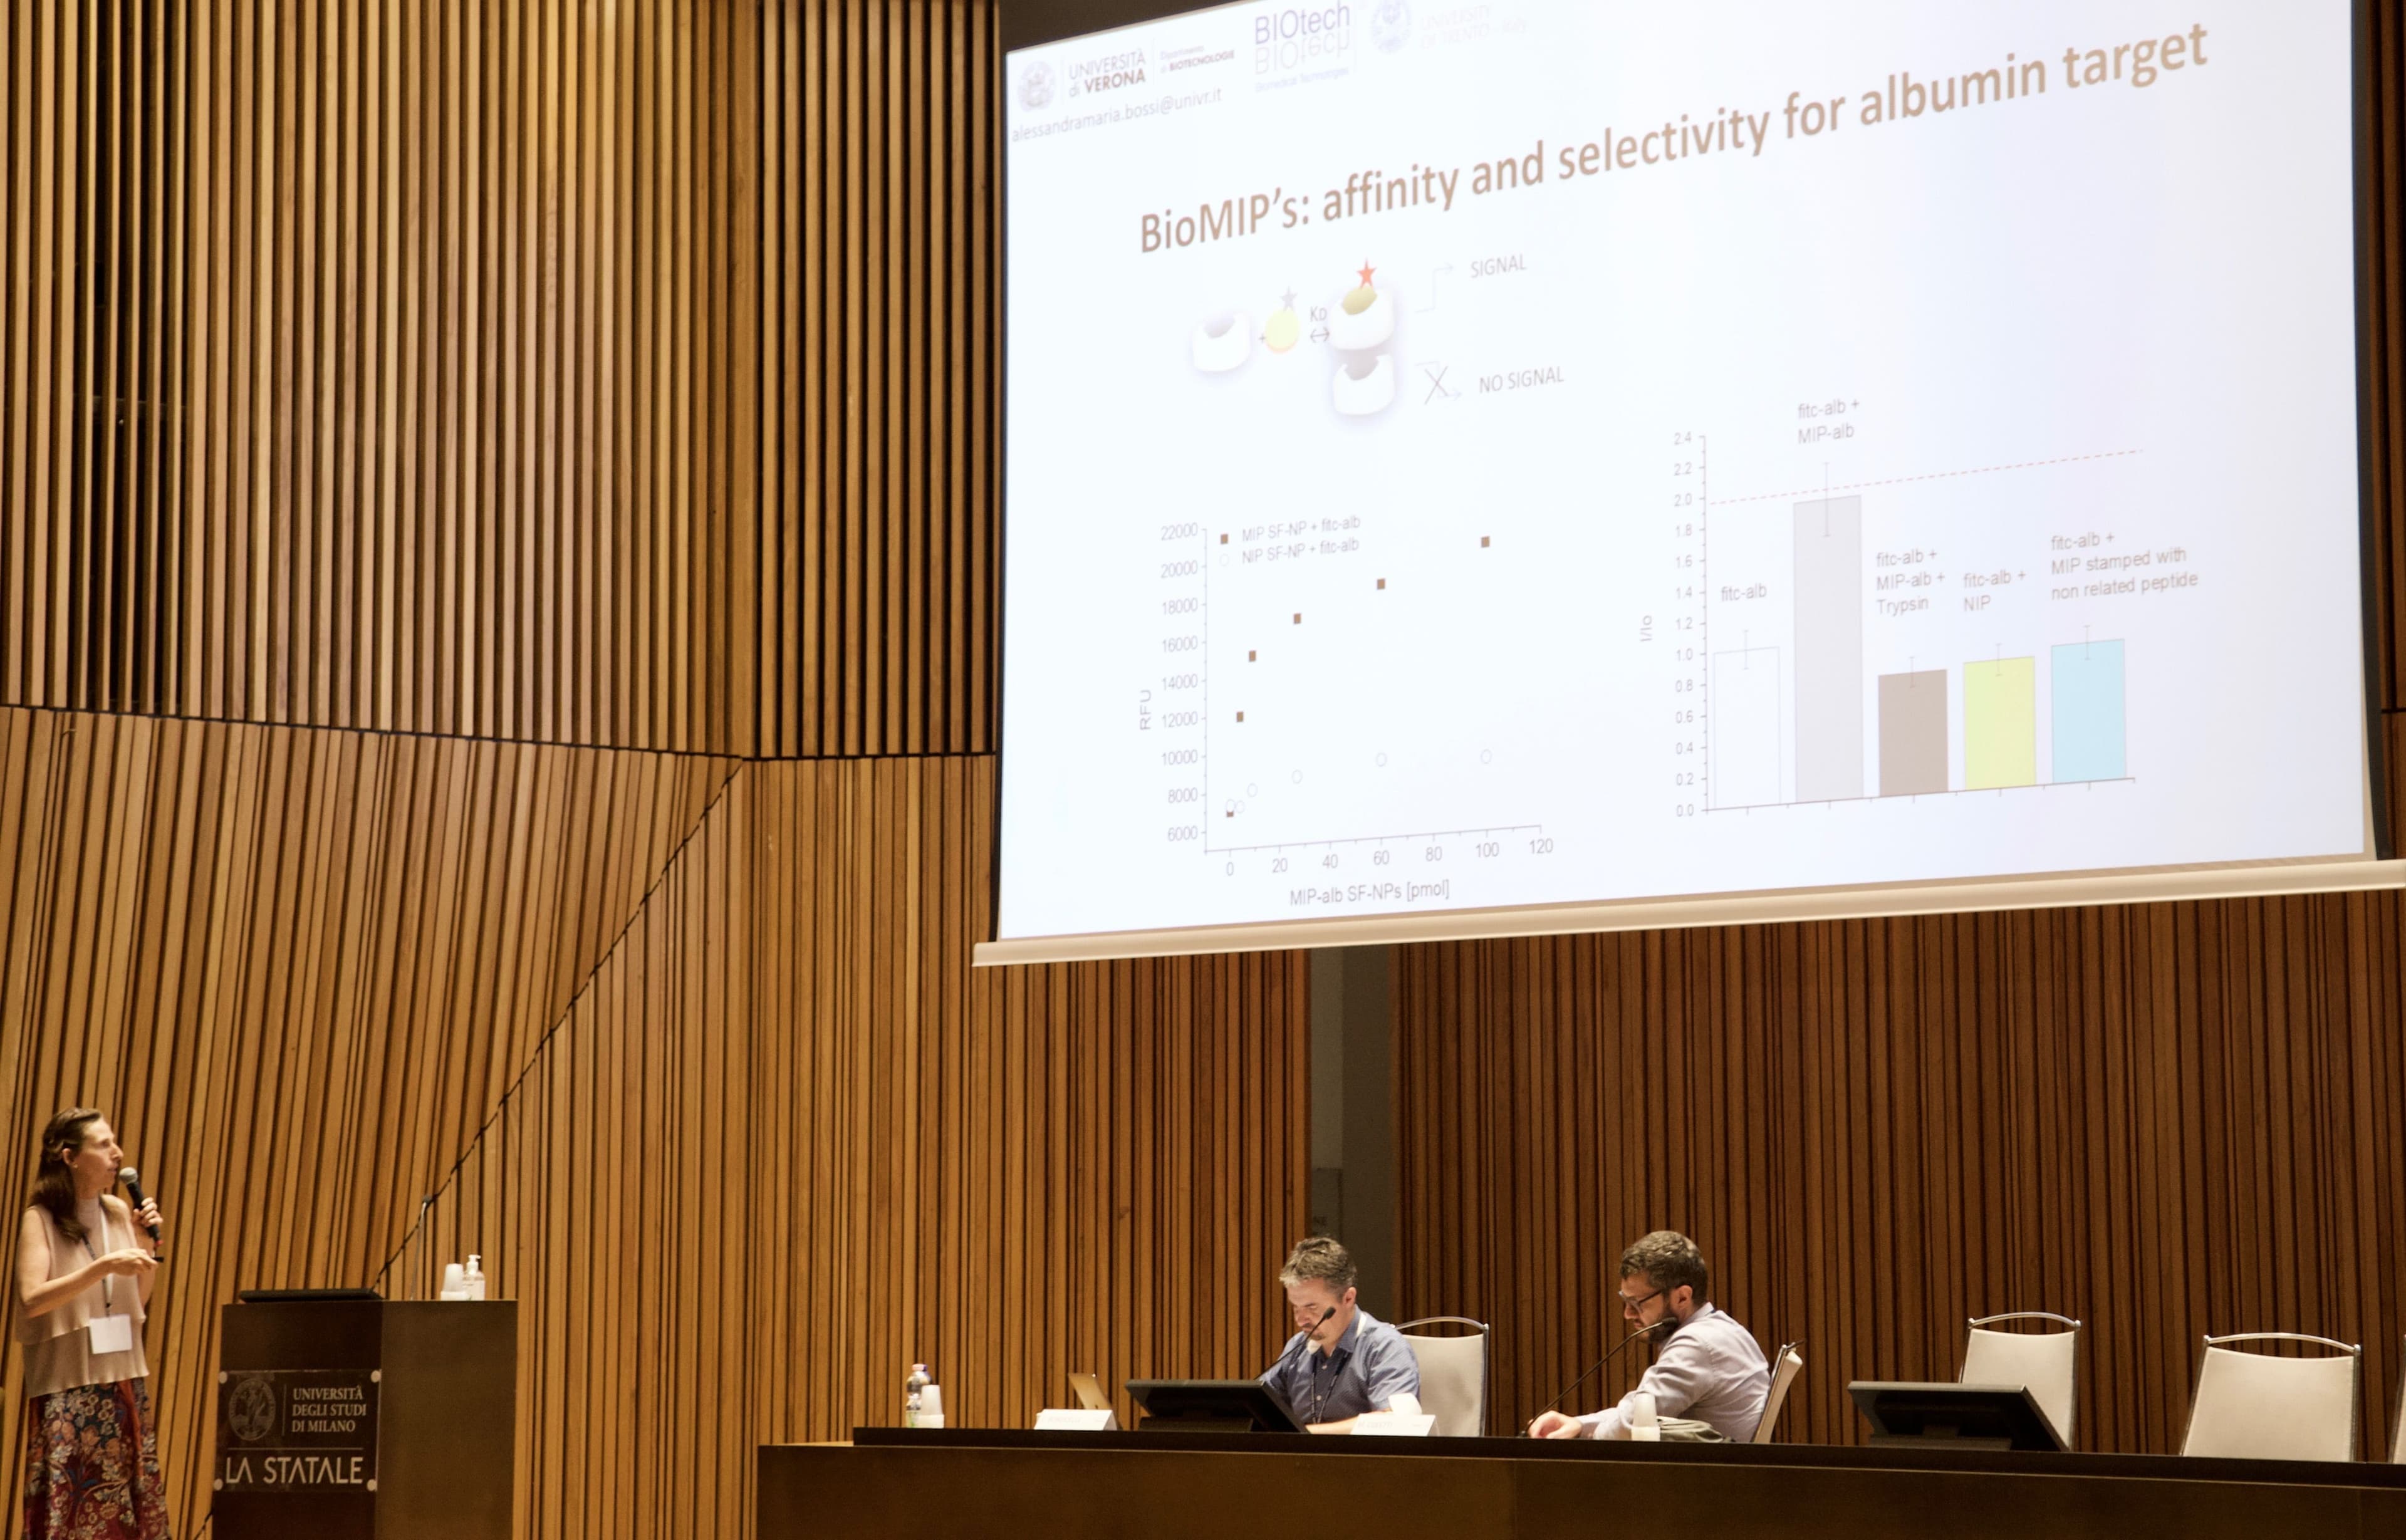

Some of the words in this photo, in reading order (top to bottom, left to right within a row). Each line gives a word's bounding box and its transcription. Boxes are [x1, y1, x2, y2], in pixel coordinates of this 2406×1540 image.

[1255, 0, 1350, 44] BIOtech
[1069, 49, 1146, 80] UNIVERSITÀ
[1069, 83, 1080, 97] di
[1085, 68, 1146, 93] VERONA
[1011, 87, 1222, 142] alessandramaria.bossi@univr.it
[1323, 164, 1460, 221] affinity
[1472, 140, 1544, 195] and
[1558, 107, 1770, 180] selectivity
[1783, 92, 1846, 142] for
[1859, 53, 2045, 125] albumin
[2063, 23, 2208, 88] target
[1470, 254, 1527, 278] SIGNAL
[1479, 375, 1502, 393] NO
[1508, 366, 1564, 390] SIGNAL
[1798, 398, 1846, 419] fitc-alb
[1851, 399, 1860, 408] +
[1674, 431, 1692, 445] 2.4
[1798, 422, 1855, 445] MIP-alb
[1674, 462, 1692, 476] 2.2
[1674, 494, 1692, 507] 2.0
[1161, 523, 1199, 541] 22000
[1242, 526, 1264, 543] MIP
[1268, 521, 1307, 539] SF-NP
[1321, 515, 1361, 533] fitc-alb
[1675, 524, 1692, 538] 1.8
[2051, 531, 2100, 551] fitc-alb
[2106, 532, 2115, 543] +
[1242, 548, 1263, 564] NIP
[1266, 543, 1305, 561] SF-NP
[1320, 537, 1360, 555] fitc-alb
[1877, 549, 1924, 568] fitc-alb
[1929, 550, 1937, 559] +
[1675, 555, 1692, 568] 1.6
[2051, 557, 2081, 575] MIP
[2086, 549, 2150, 573] stamped
[2157, 546, 2187, 564] with
[1161, 561, 1199, 579] 20000
[1877, 571, 1932, 591] MIP-alb
[1937, 573, 1945, 581] +
[1963, 569, 2011, 588] fitc-alb
[2018, 570, 2026, 581] +
[2051, 585, 2079, 601] non
[2084, 577, 2135, 597] related
[2141, 570, 2199, 592] peptide
[1675, 586, 1692, 600] 1.4
[1721, 582, 1768, 601] fitc-alb
[1161, 599, 1199, 615] 18000
[1877, 595, 1929, 617] Trypsin
[1964, 595, 1991, 612] NIP
[1675, 617, 1693, 630] 1.2
[1161, 637, 1199, 653] 16000
[1675, 648, 1693, 662] 1.0
[1161, 674, 1199, 690] 14000
[1675, 679, 1694, 692] 0.8
[1139, 689, 1152, 730] RFU
[1675, 710, 1694, 724] 0.6
[1161, 712, 1199, 728] 12000
[1675, 742, 1694, 755] 0.4
[1161, 749, 1199, 765] 10000
[1675, 773, 1694, 786] 0.2
[1167, 788, 1199, 803] 8000
[1675, 804, 1694, 817] 0.0
[1167, 825, 1199, 841] 6000
[1425, 846, 1442, 861] 80
[1475, 842, 1500, 858] 100
[1529, 838, 1554, 854] 120
[1272, 858, 1288, 873] 20
[1322, 854, 1338, 869] 40
[1373, 850, 1390, 866] 60
[1226, 861, 1234, 877] 0
[1289, 885, 1343, 907] MIP-alb
[1346, 881, 1402, 902] SF-NPs
[1406, 878, 1450, 902] [pmol]
[293, 1385, 363, 1401] UNIVERSITÀ
[292, 1403, 328, 1417] DEGLI
[330, 1403, 367, 1417] STUDI
[292, 1420, 305, 1433] DI
[308, 1420, 356, 1433] MILANO
[226, 1457, 253, 1484] LA
[263, 1457, 363, 1484] STATALE
